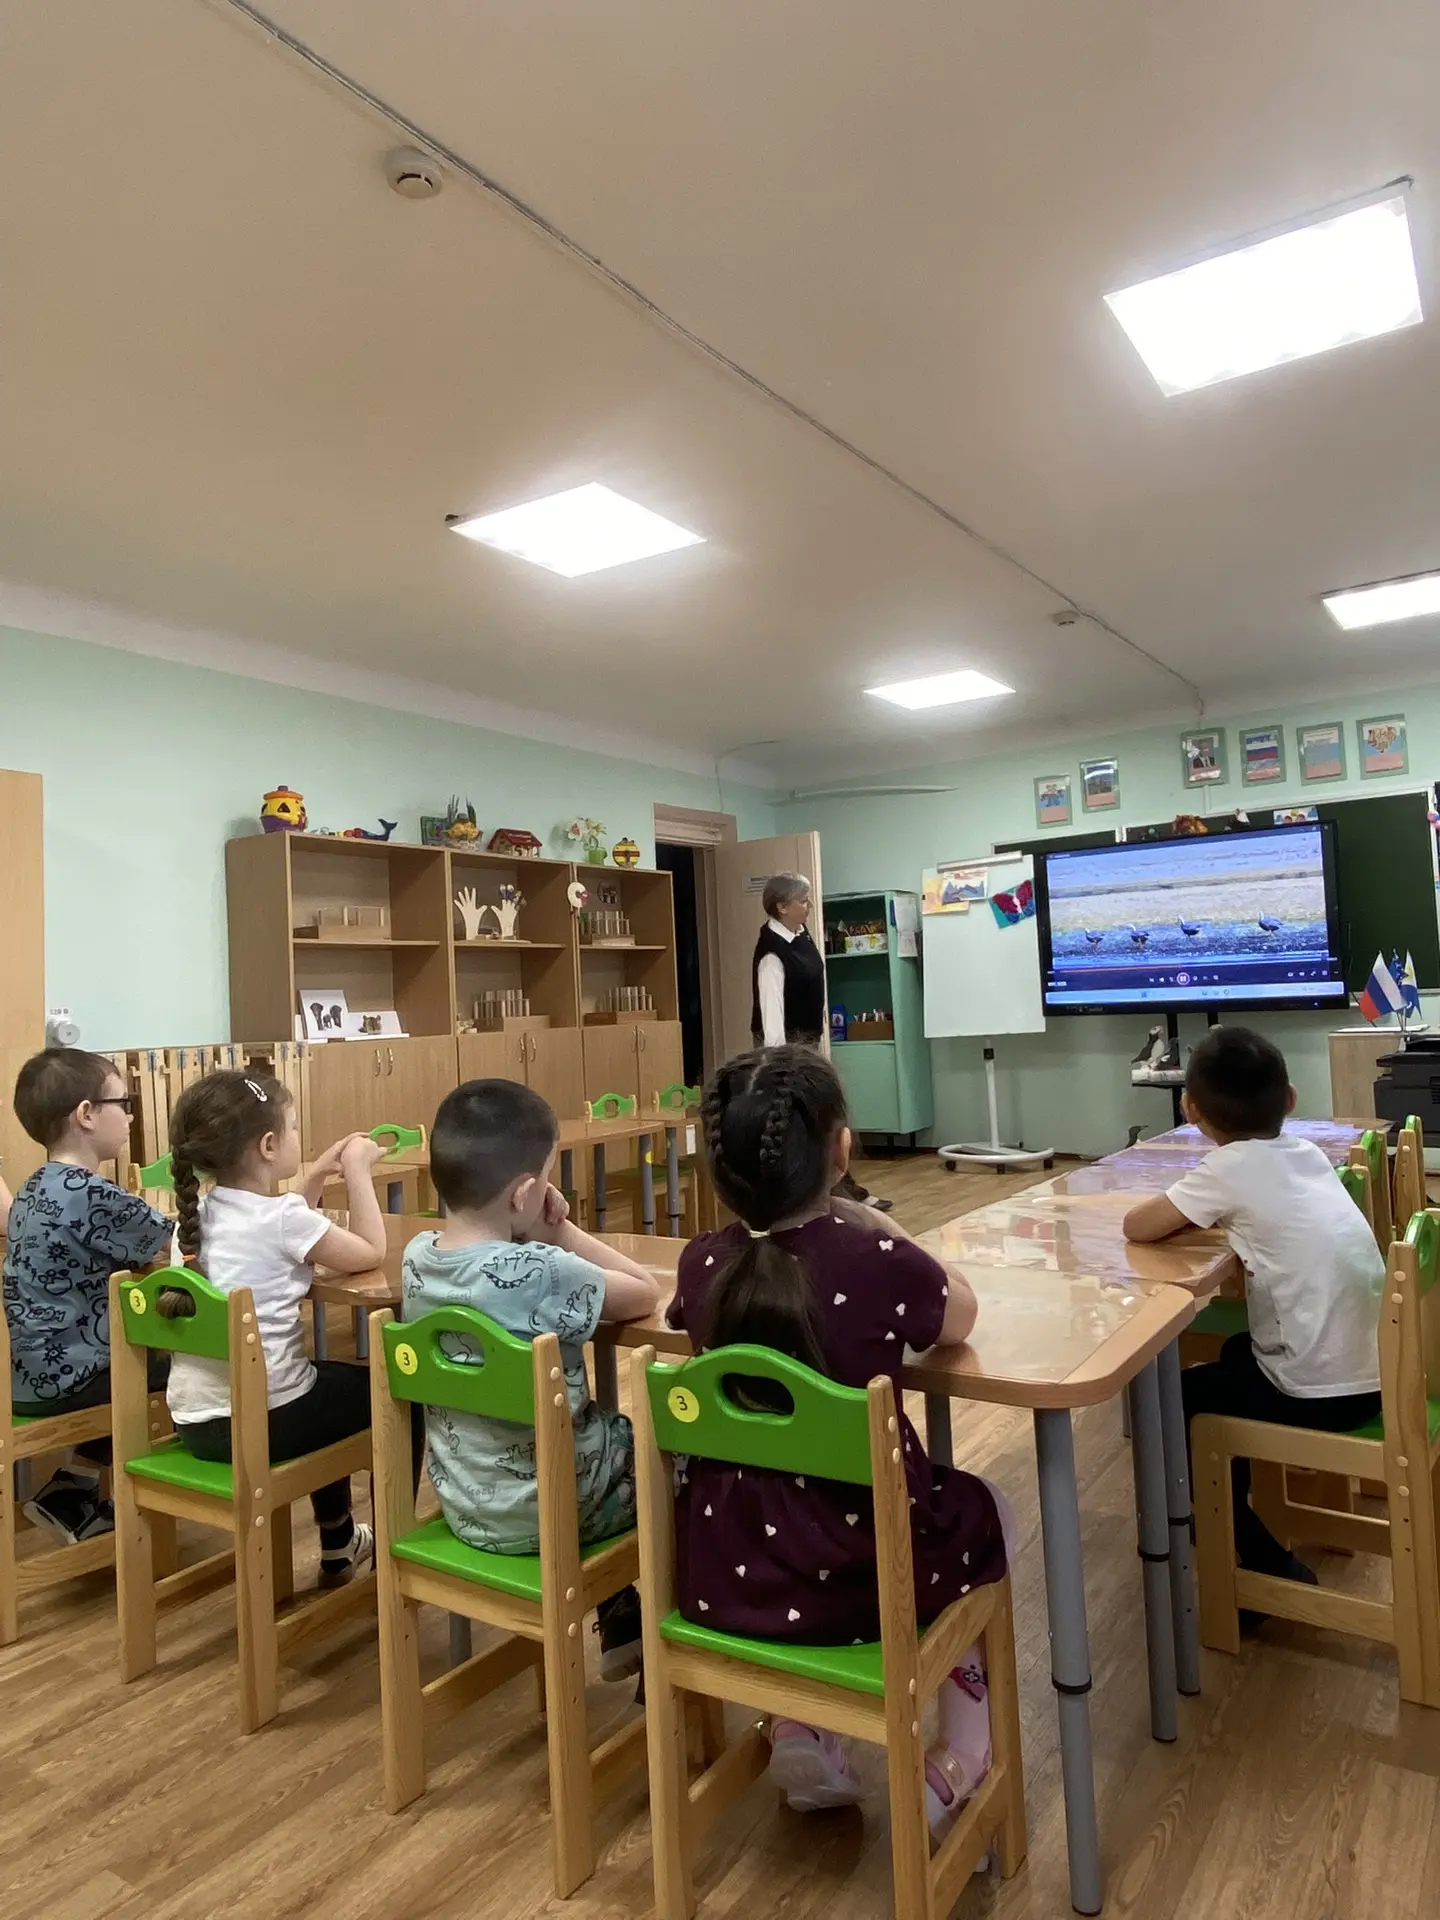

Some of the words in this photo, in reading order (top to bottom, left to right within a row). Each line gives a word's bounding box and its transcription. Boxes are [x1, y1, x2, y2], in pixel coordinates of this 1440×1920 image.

[134, 1295, 141, 1307] 3
[402, 1351, 410, 1366] 3
[676, 1395, 688, 1411] 3
